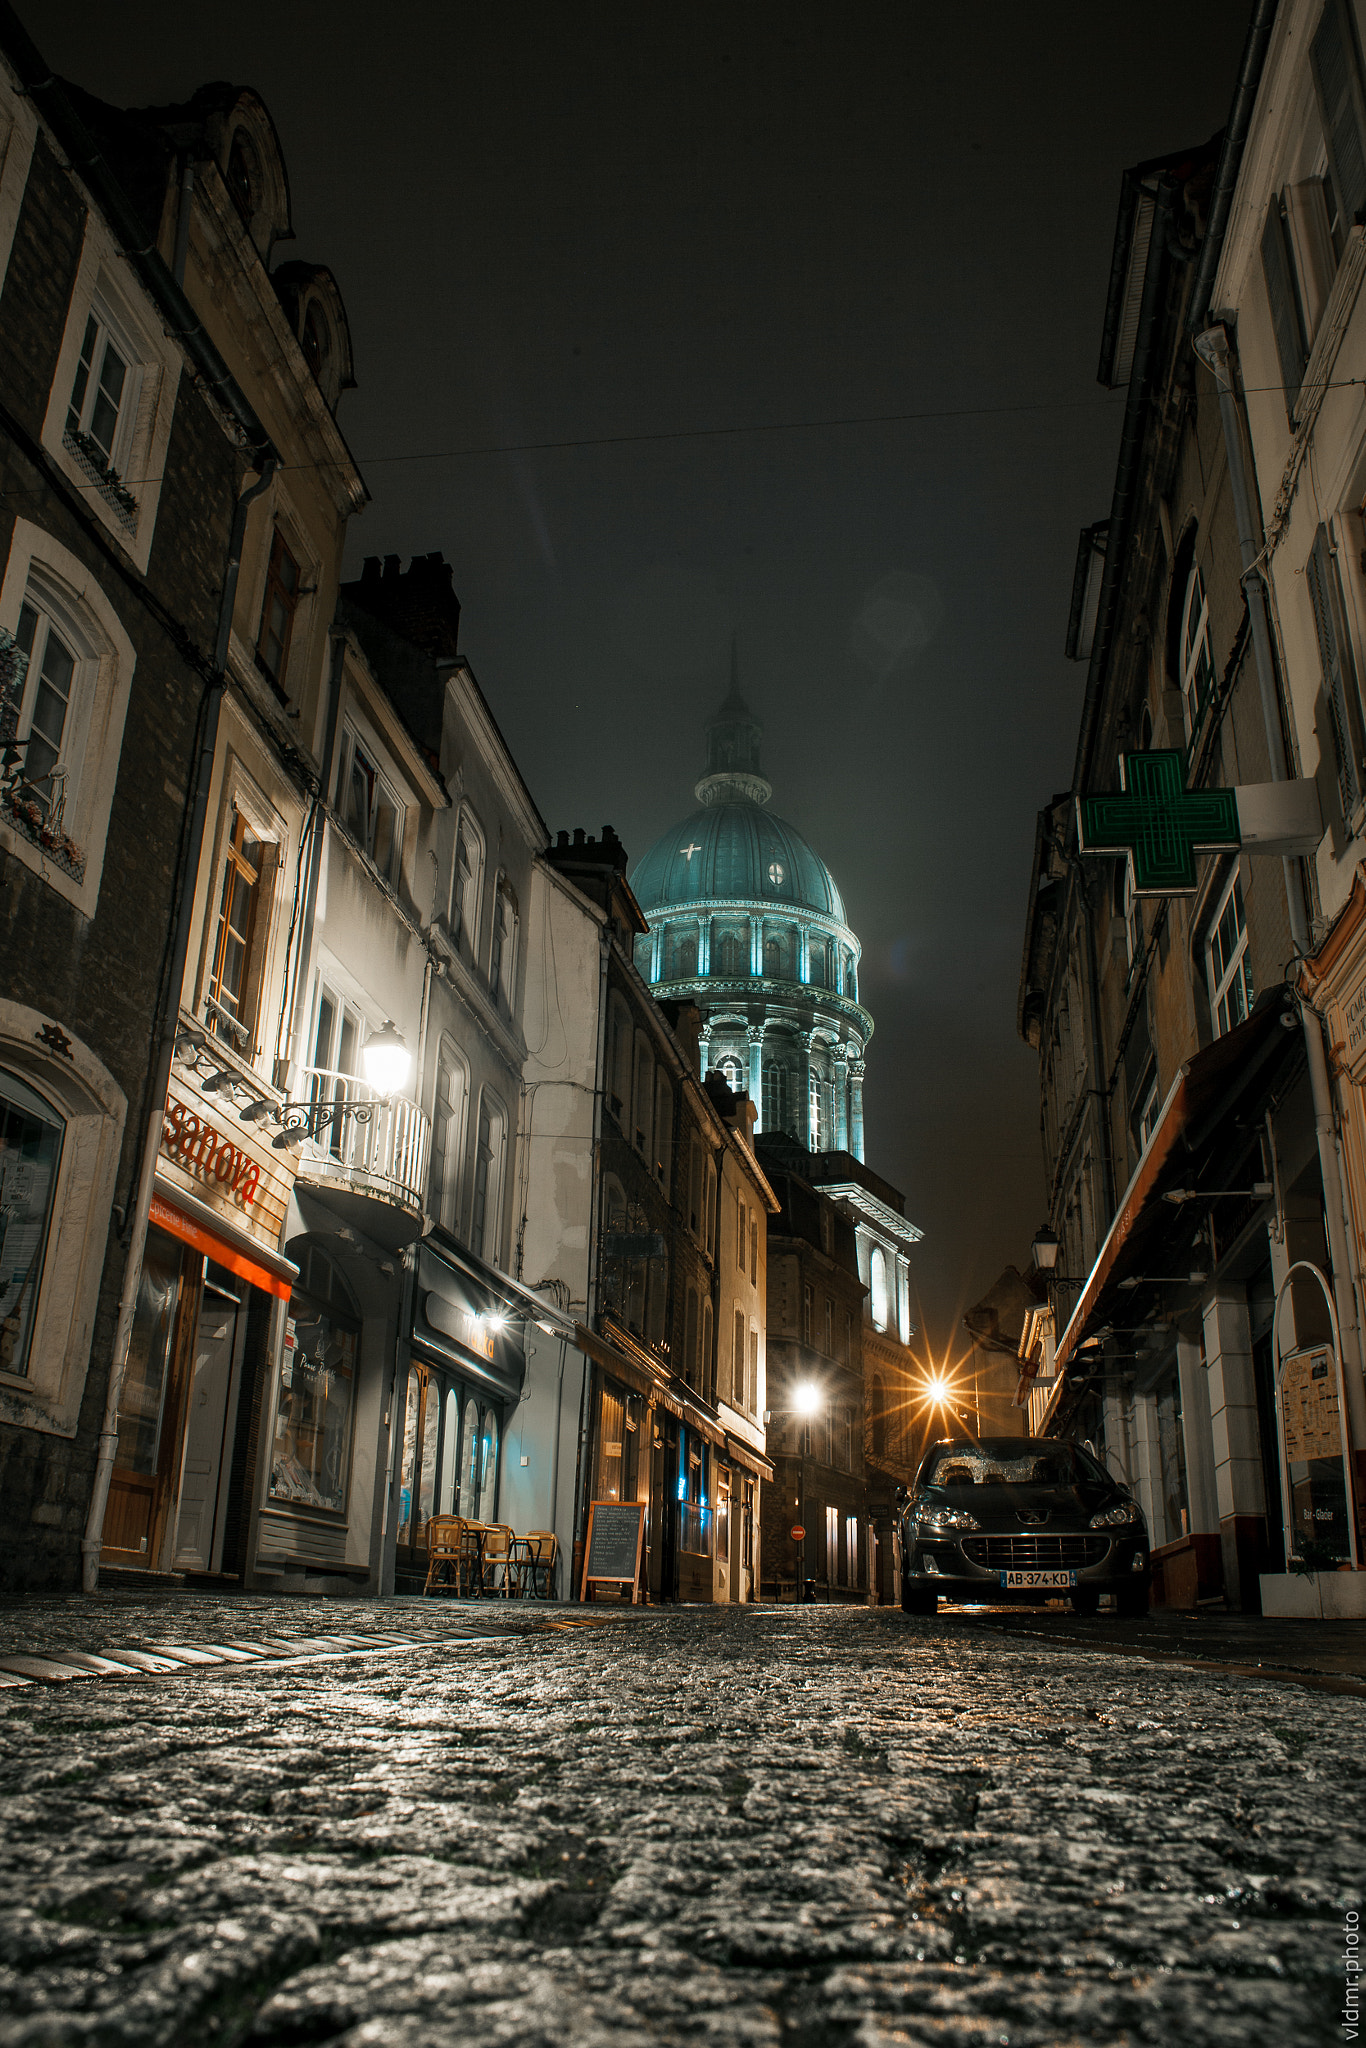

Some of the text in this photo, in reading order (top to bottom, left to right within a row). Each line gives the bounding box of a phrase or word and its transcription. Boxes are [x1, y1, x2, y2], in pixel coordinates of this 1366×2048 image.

[164, 1101, 260, 1205] sanova
[1303, 1508, 1312, 1520] Bar
[1008, 1573, 1068, 1585] AB-374-KD
